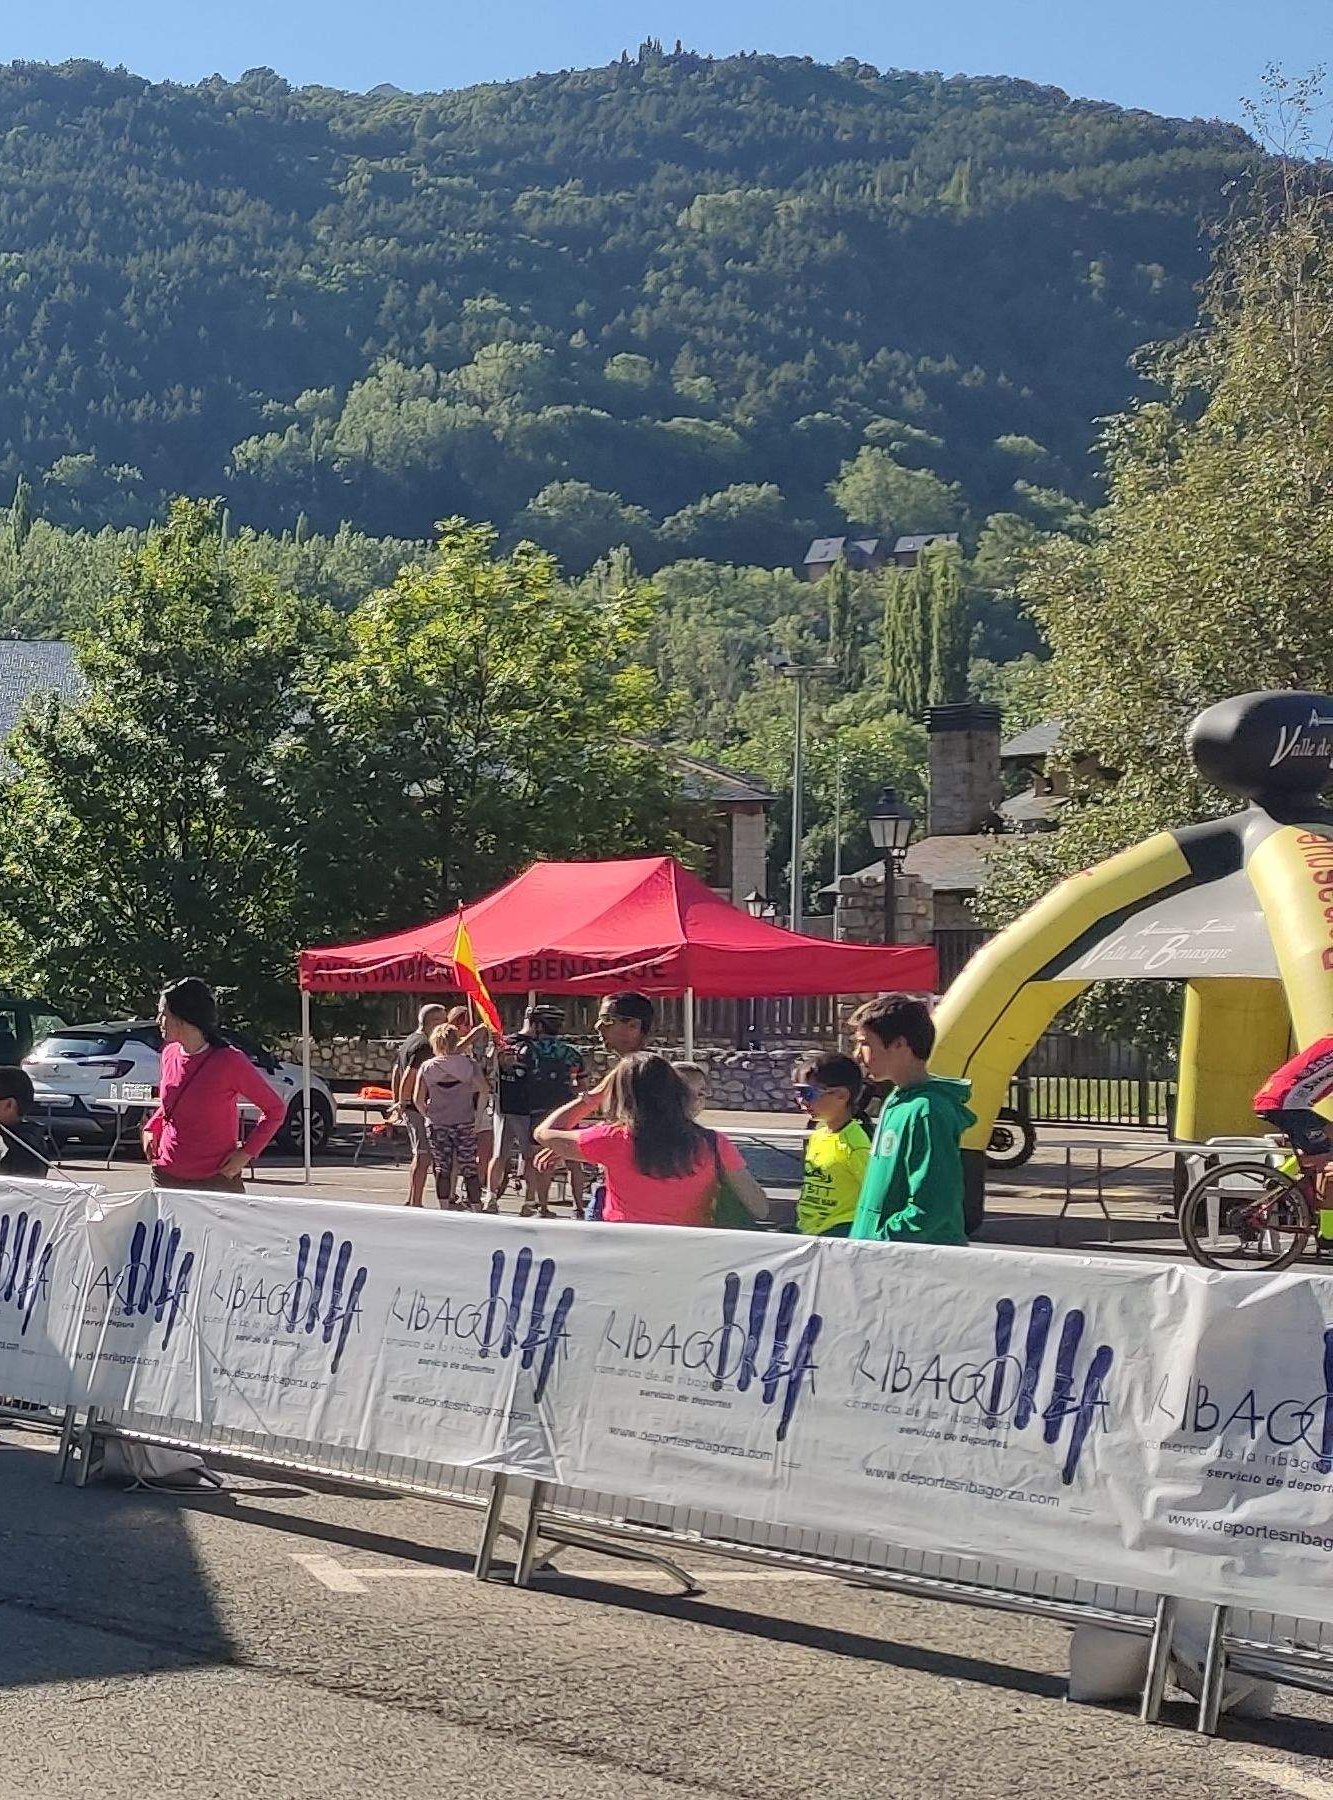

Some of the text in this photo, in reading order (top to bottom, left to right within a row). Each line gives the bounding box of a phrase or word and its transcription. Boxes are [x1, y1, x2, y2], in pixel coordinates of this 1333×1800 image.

[1080, 934, 1233, 970] Valle de Benasque
[491, 958, 521, 982] DE
[1206, 1468, 1261, 1484] servicio
[1266, 1475, 1284, 1487] de
